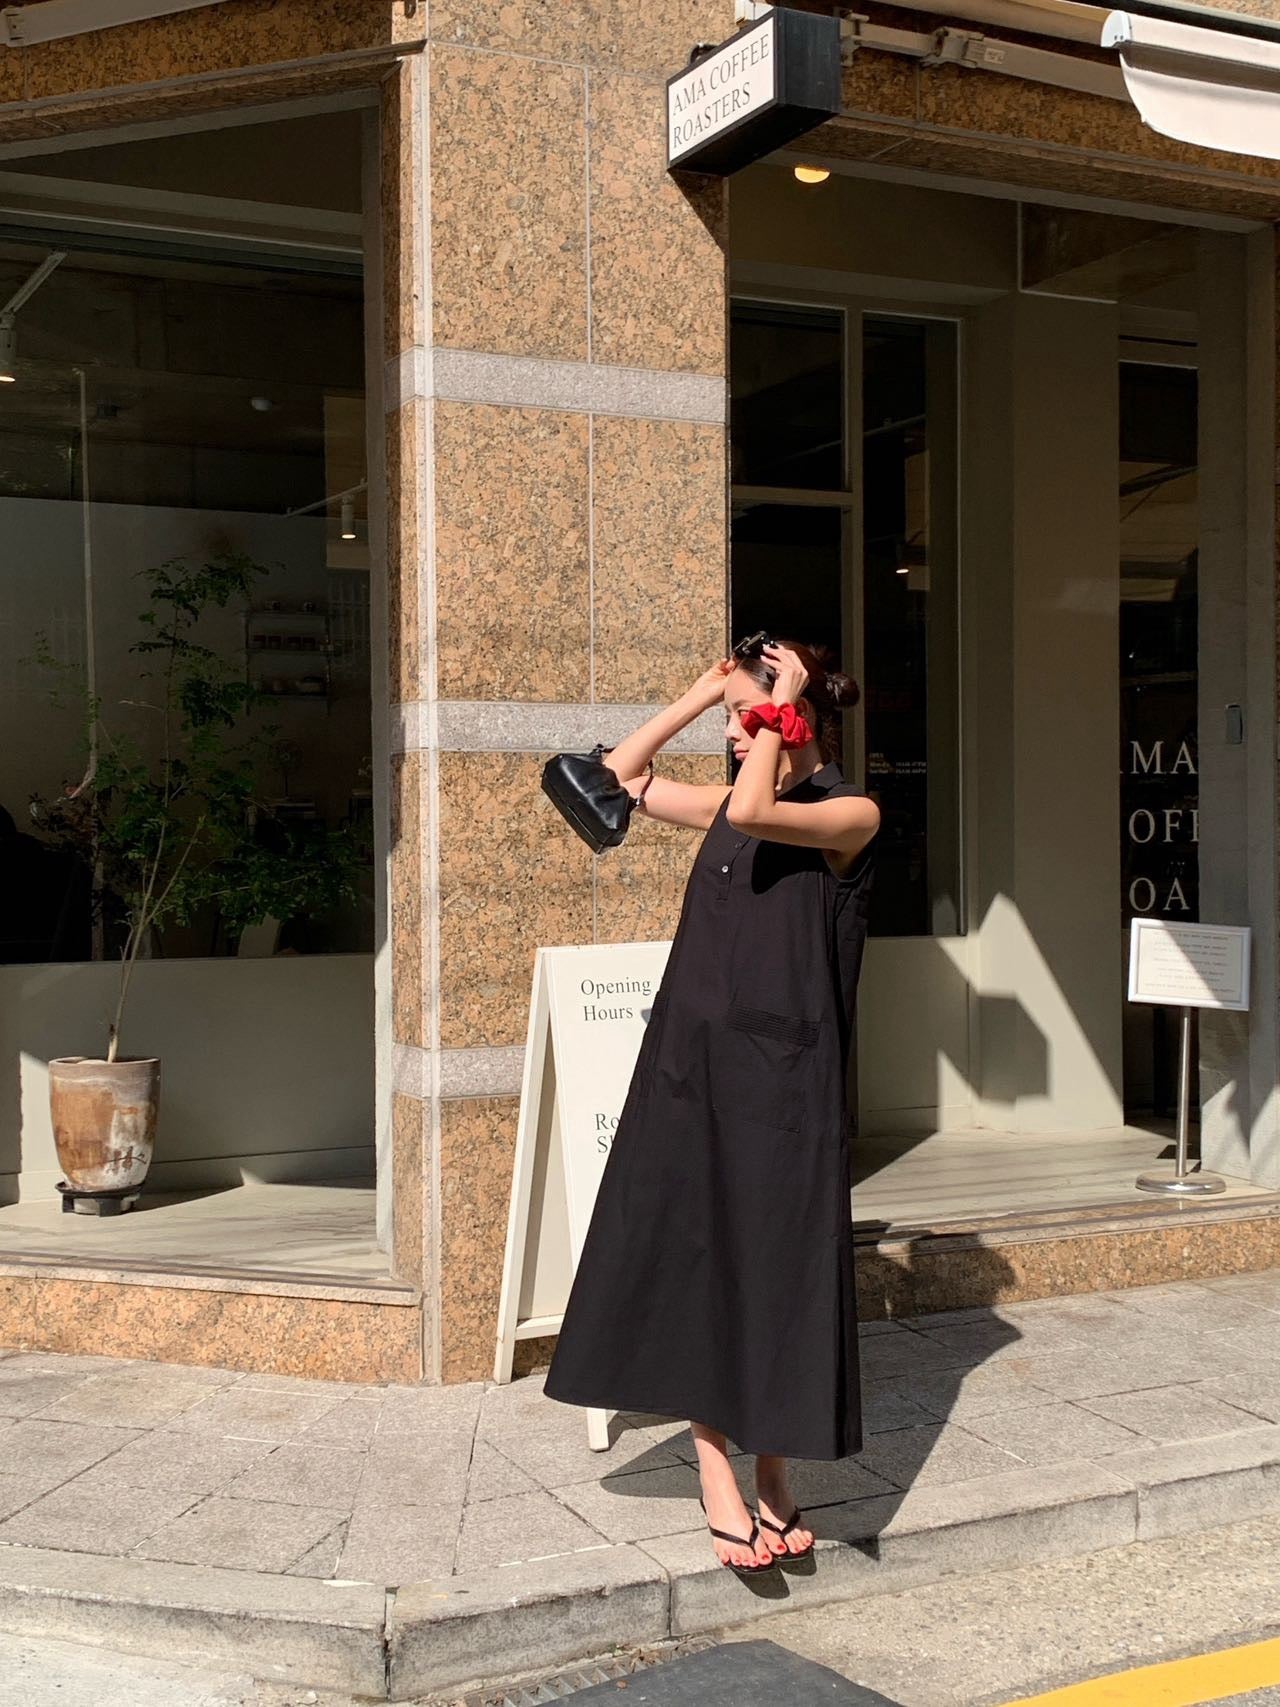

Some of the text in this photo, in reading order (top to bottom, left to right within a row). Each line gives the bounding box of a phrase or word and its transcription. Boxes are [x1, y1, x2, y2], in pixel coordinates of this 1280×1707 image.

[673, 34, 770, 116] AMA COFFEE
[673, 81, 751, 148] ROASTERS
[1120, 740, 1198, 775] MA
[581, 977, 651, 999] Opening
[584, 1005, 633, 1021] Hours
